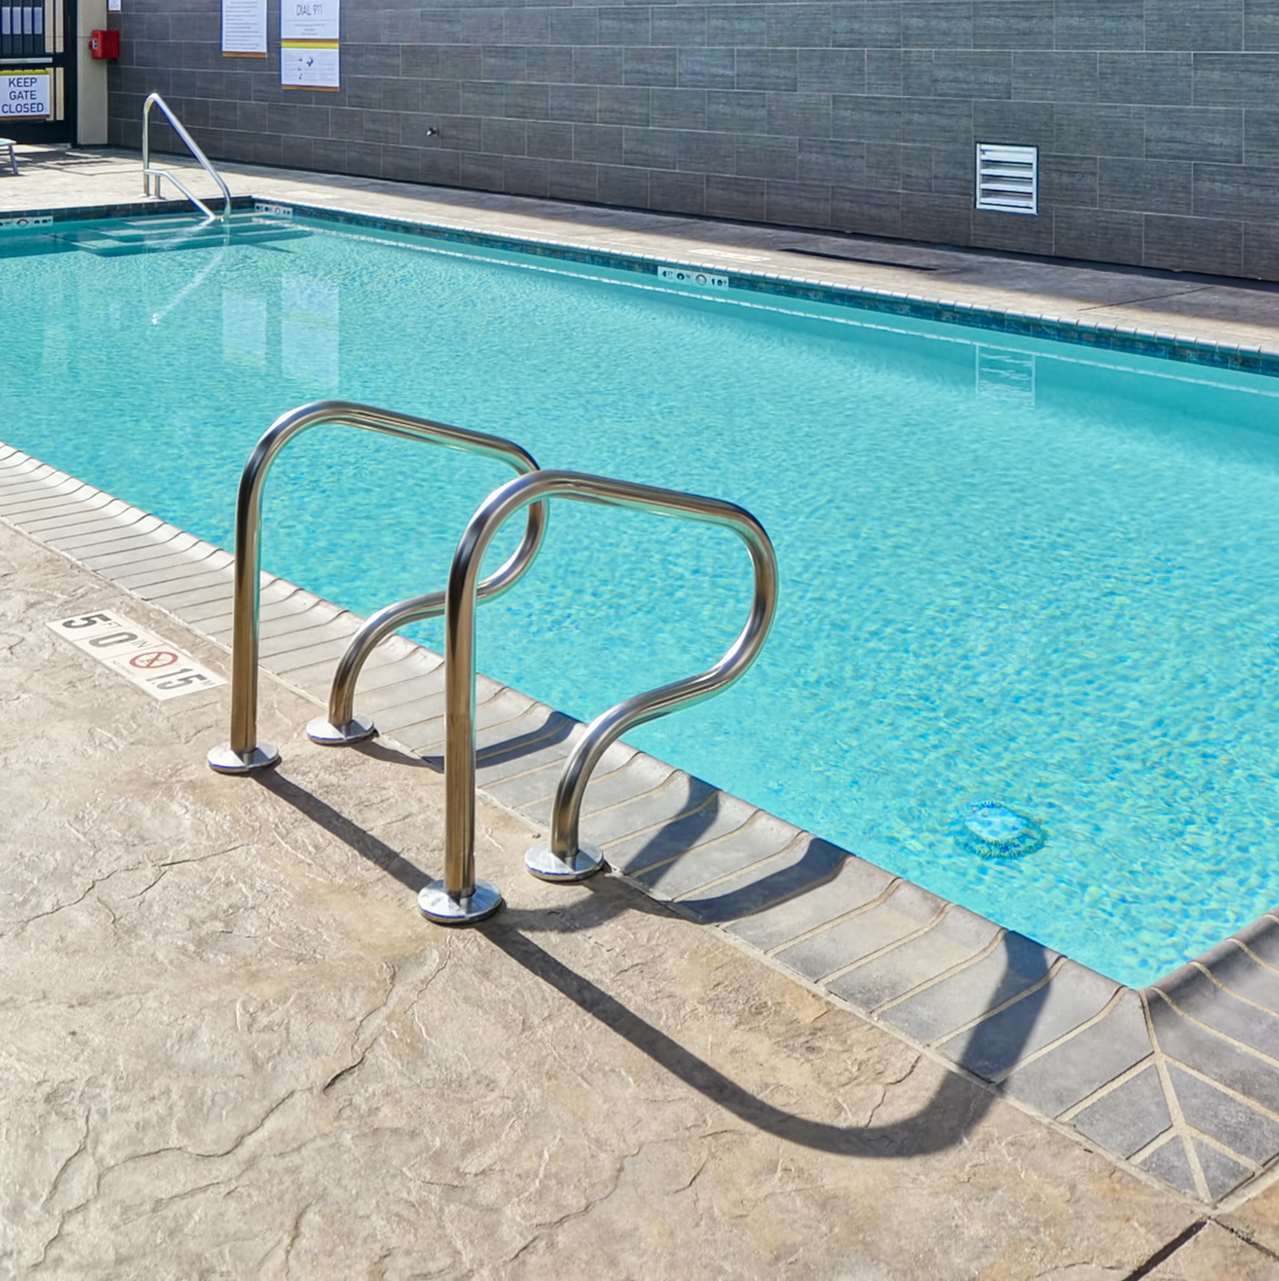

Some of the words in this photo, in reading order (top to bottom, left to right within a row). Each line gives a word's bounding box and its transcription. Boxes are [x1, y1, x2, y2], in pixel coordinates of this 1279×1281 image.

[296, 4, 312, 16] DIAL
[313, 4, 323, 16] 911
[8, 77, 38, 88] KEEP
[9, 90, 37, 101] GATE
[1, 102, 45, 114] CLOSED
